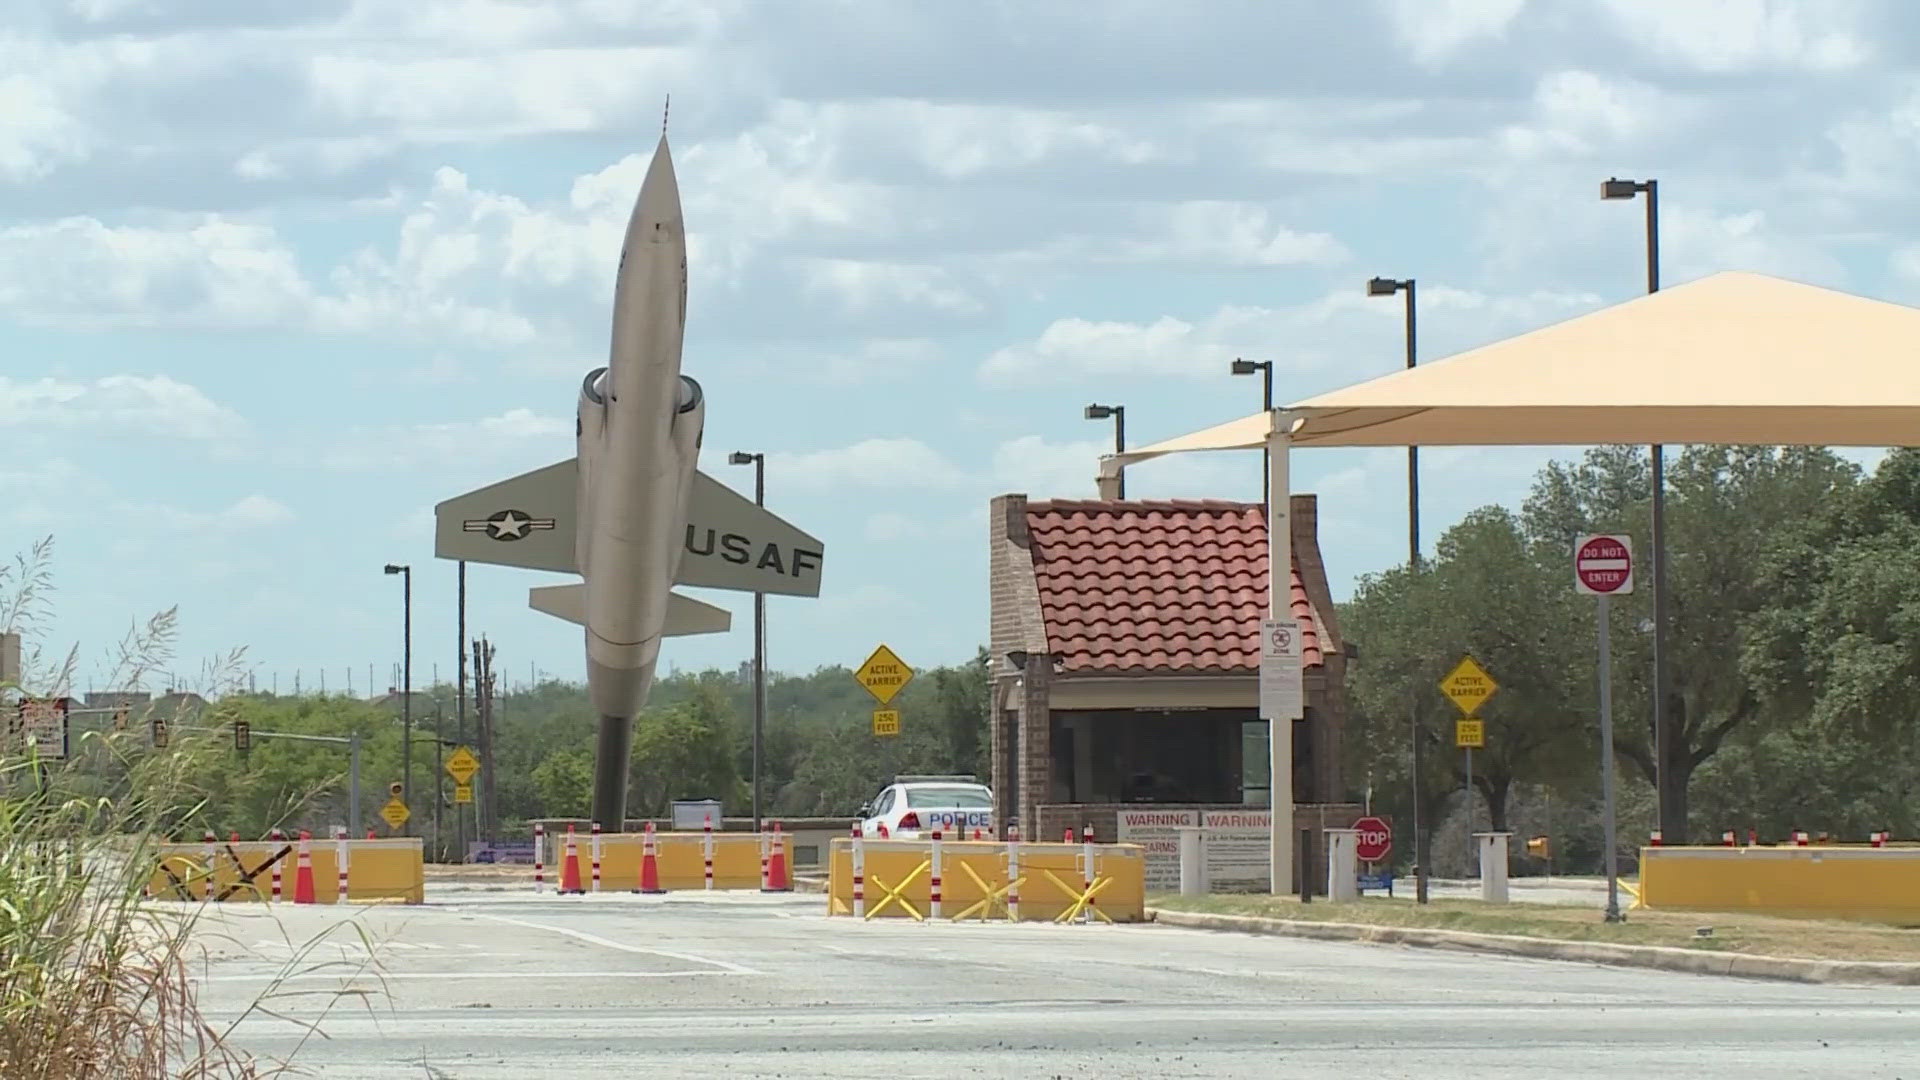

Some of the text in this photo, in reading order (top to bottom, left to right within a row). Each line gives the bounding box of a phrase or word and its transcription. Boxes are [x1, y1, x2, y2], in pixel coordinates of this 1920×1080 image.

[685, 523, 823, 577] USAF
[1583, 546, 1624, 558] DO NOT
[1588, 571, 1620, 583] ENTER
[869, 664, 899, 675] ACTIVE
[866, 676, 902, 686] BARRIER
[1454, 676, 1483, 686] ACTIVE
[1450, 687, 1487, 697] BARRIER
[877, 723, 895, 732] FEET
[929, 812, 990, 827] POLICE
[1125, 813, 1191, 826] WARNING
